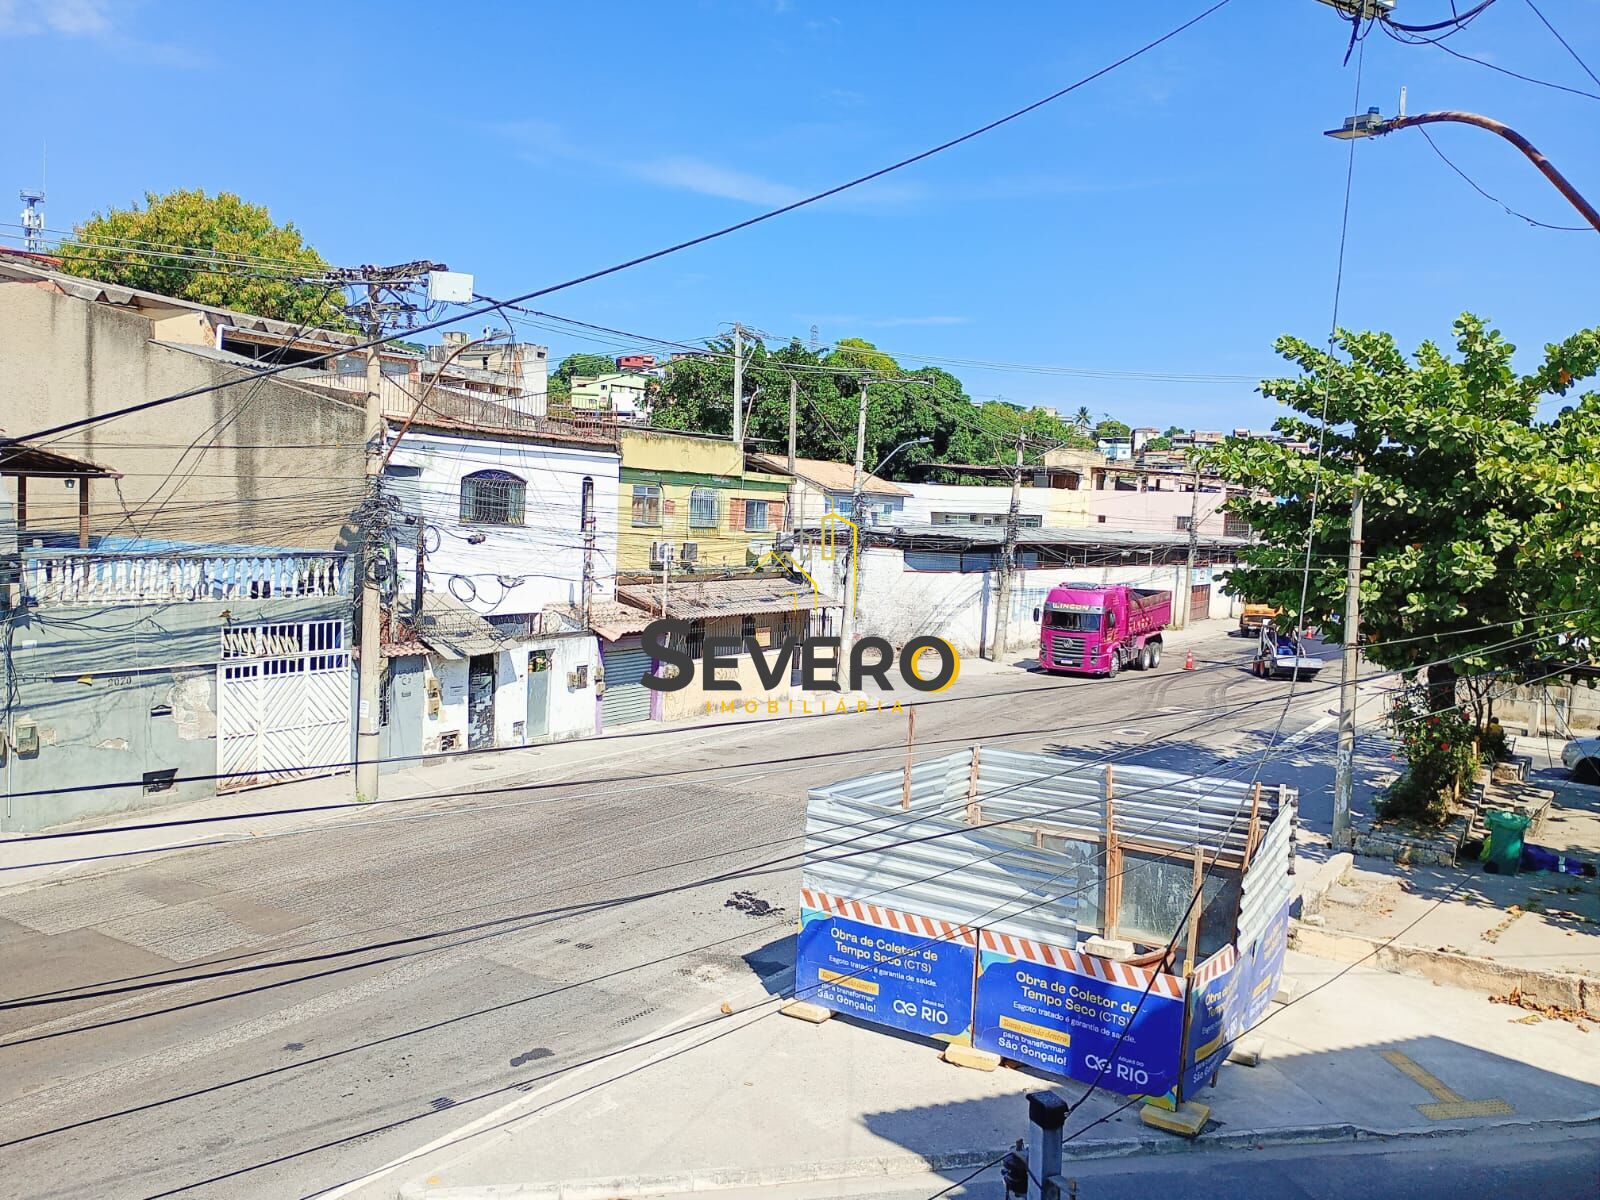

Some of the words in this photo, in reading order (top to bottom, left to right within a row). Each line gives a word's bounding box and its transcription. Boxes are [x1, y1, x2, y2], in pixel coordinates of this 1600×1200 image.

[830, 927, 857, 943] Obra
[860, 936, 874, 946] de
[923, 950, 938, 961] de
[835, 941, 871, 959] Tempo
[904, 959, 932, 974] (CTS)
[836, 994, 877, 1013] Gonçalo!
[1015, 971, 1048, 989] Obra
[1050, 981, 1066, 993] de
[1069, 985, 1119, 1009] Coletor
[1121, 1001, 1137, 1015] de
[1021, 985, 1062, 1006] Tempo
[1065, 998, 1096, 1017] Seco
[921, 1006, 948, 1025] RIO
[1013, 1001, 1037, 1013] Esgoto
[1038, 1008, 1064, 1021] tratado
[1070, 1019, 1099, 1033] garantia
[1100, 1027, 1110, 1036] de
[998, 1037, 1018, 1051] São
[1020, 1044, 1067, 1066] Gonçalo!
[1002, 1032, 1020, 1041] para
[1020, 1036, 1066, 1054] transformar
[1117, 1063, 1148, 1085] RIO
